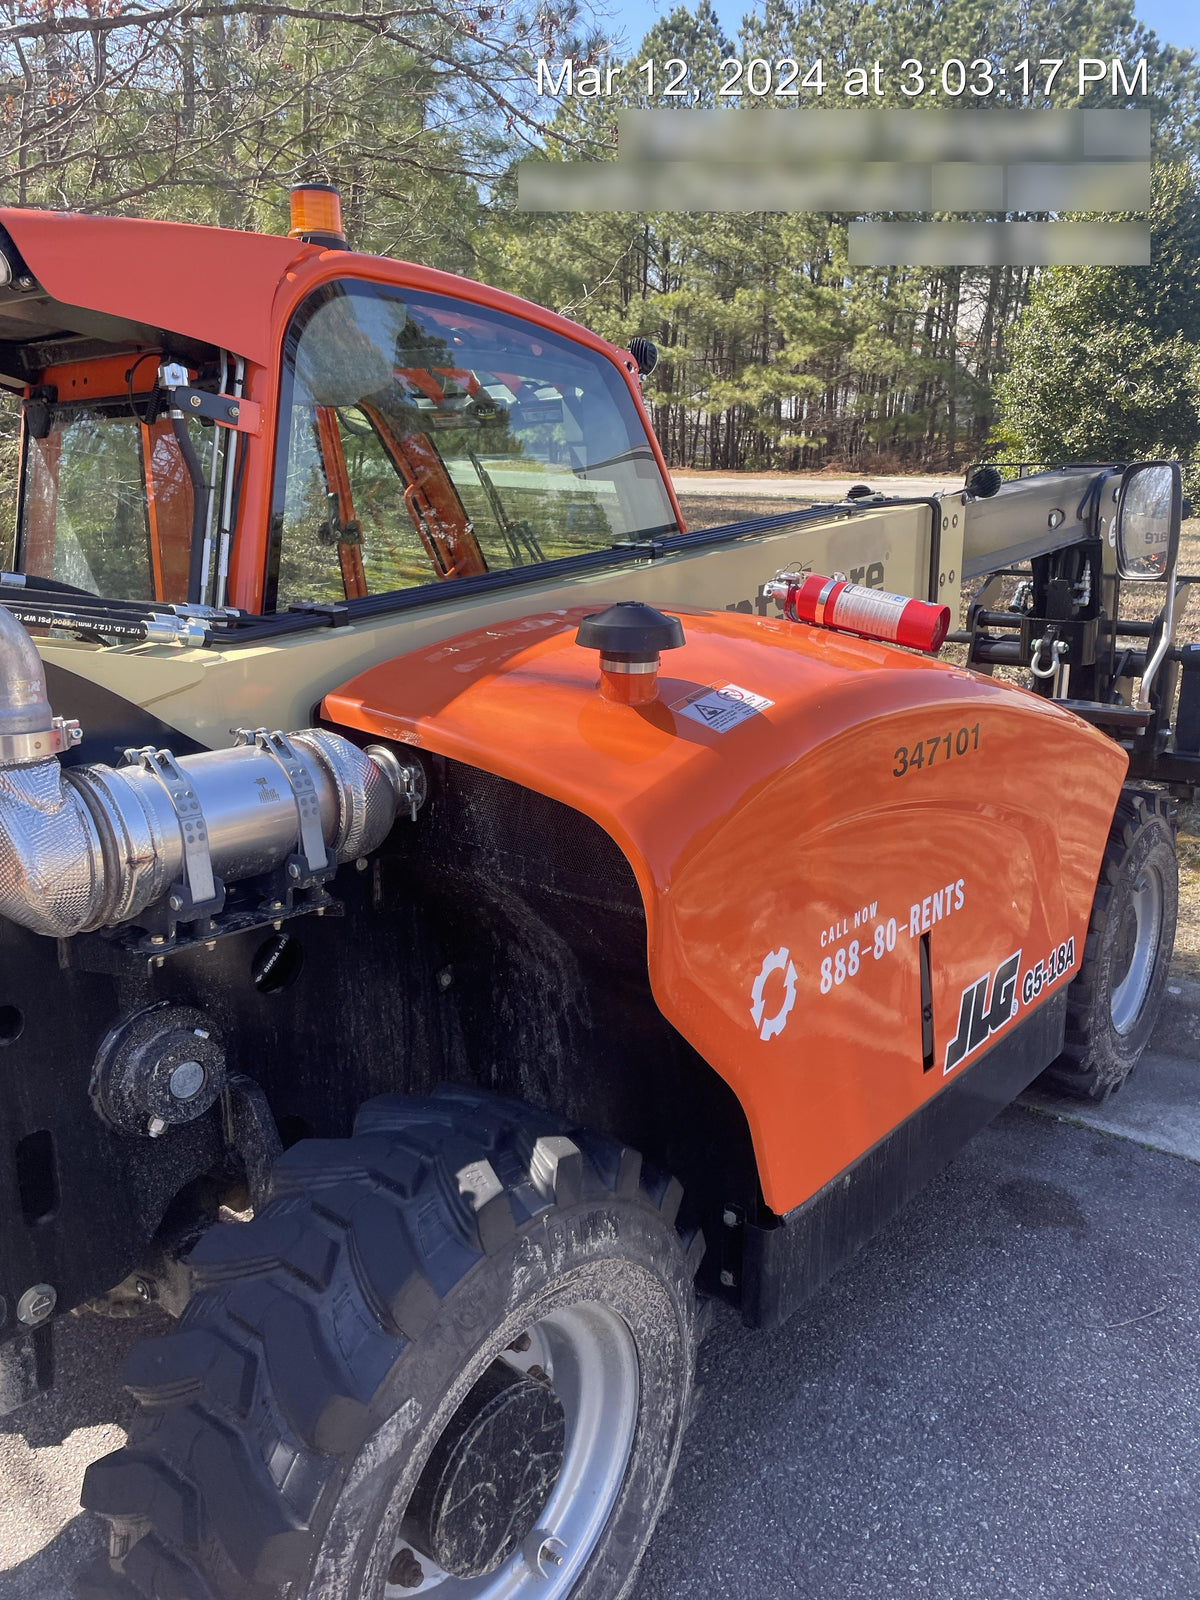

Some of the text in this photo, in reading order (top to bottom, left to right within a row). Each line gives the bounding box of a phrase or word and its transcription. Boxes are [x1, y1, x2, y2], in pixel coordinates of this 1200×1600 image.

[24, 614, 37, 622] WP
[38, 616, 51, 624] PSI
[893, 722, 980, 778] 347101
[820, 900, 878, 948] CALL NOW
[820, 878, 965, 995] 888-80-RENTS
[943, 935, 1075, 1076] JLG G5-18A
